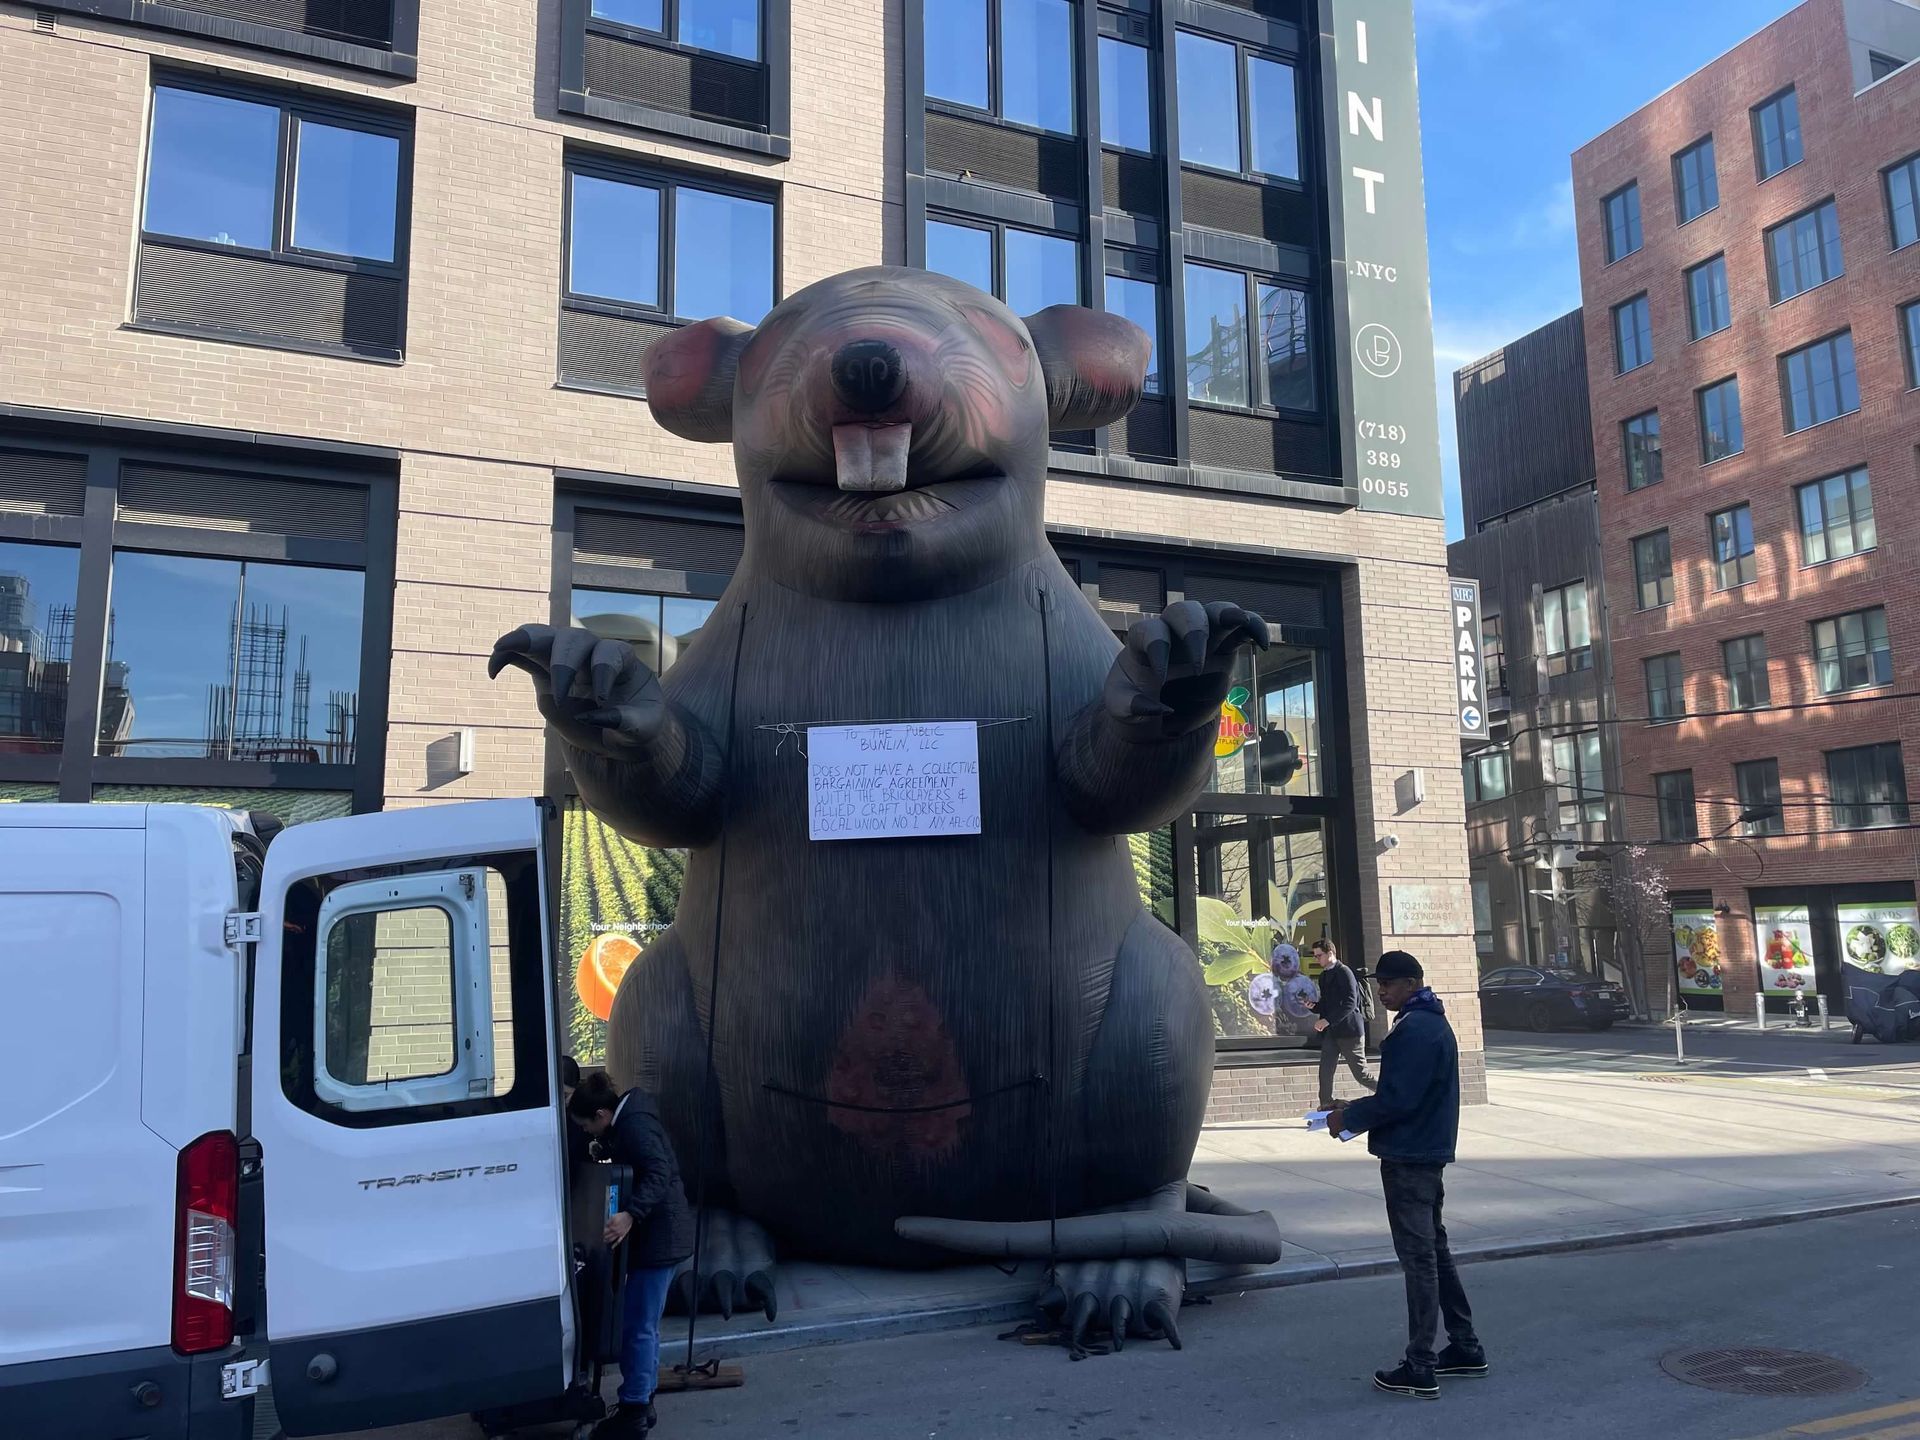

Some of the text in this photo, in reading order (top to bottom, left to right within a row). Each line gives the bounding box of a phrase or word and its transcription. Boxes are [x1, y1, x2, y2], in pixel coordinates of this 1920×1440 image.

[1350, 261, 1397, 283] .NYC
[1358, 419, 1406, 444] (718)
[1367, 450, 1400, 468] 389
[1362, 477, 1409, 498] 0055
[1456, 606, 1478, 702] PARK
[843, 724, 944, 739] TO THE PUBLIC
[919, 739, 939, 750] LLC
[812, 761, 978, 777] DOES NOT HAVE A COLLECTIVE
[814, 776, 957, 791] BARGAINING AGREEMENT
[816, 788, 969, 805] WITH THE BRICKLAYERS &
[815, 801, 955, 818] ALLIED CRAFT WORKERS
[813, 817, 852, 832] LOCAL
[855, 817, 887, 830] UNION
[1400, 902, 1411, 910] TO
[1412, 902, 1421, 910] 21
[1422, 902, 1443, 910] INDIA
[1403, 912, 1409, 920] &
[1410, 912, 1420, 920] 23
[1421, 912, 1442, 920] INDIA
[1860, 911, 1902, 920] SALADS
[590, 921, 673, 932] Your Neighborhoo
[358, 1163, 518, 1190] TRANSIT 250
